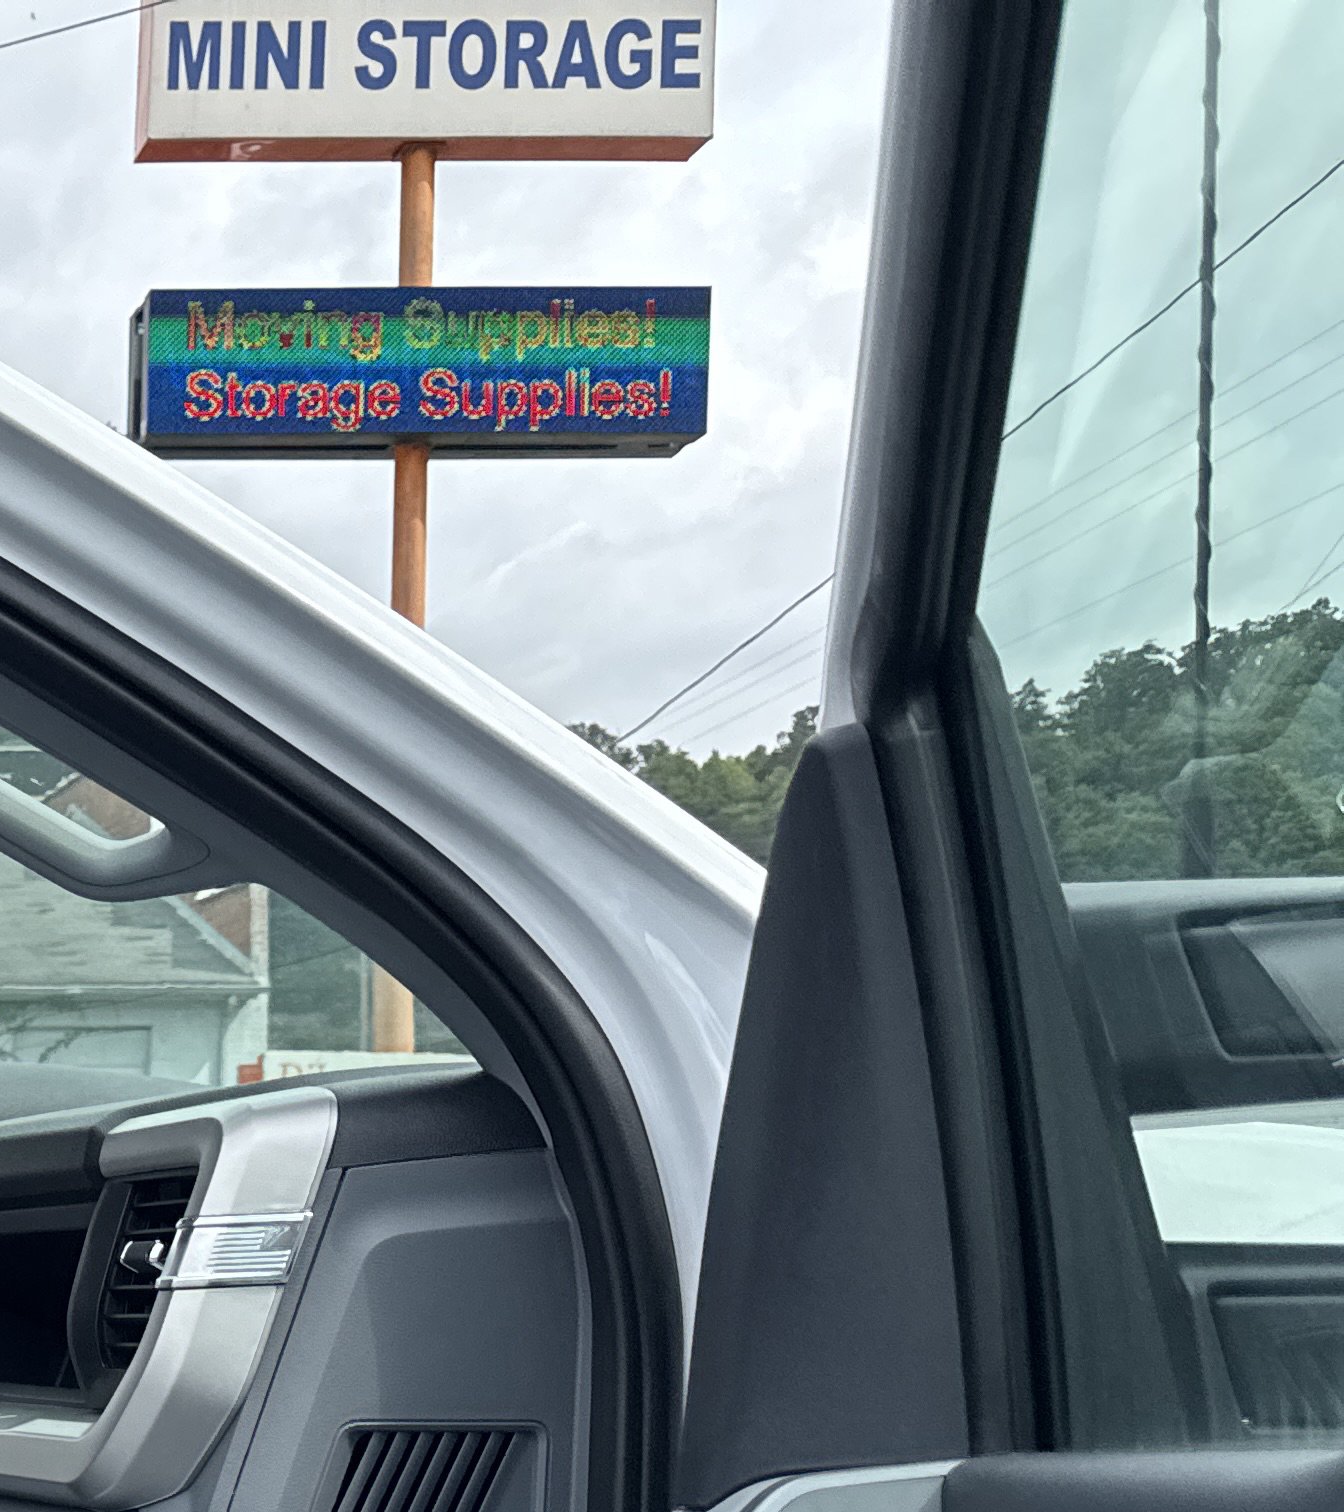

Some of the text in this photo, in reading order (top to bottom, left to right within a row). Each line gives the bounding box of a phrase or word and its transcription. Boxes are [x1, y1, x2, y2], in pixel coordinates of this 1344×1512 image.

[167, 17, 703, 91] MINI STORAGE
[187, 296, 657, 362] Moving Supplies!
[183, 366, 673, 432] Storage Supplies!
